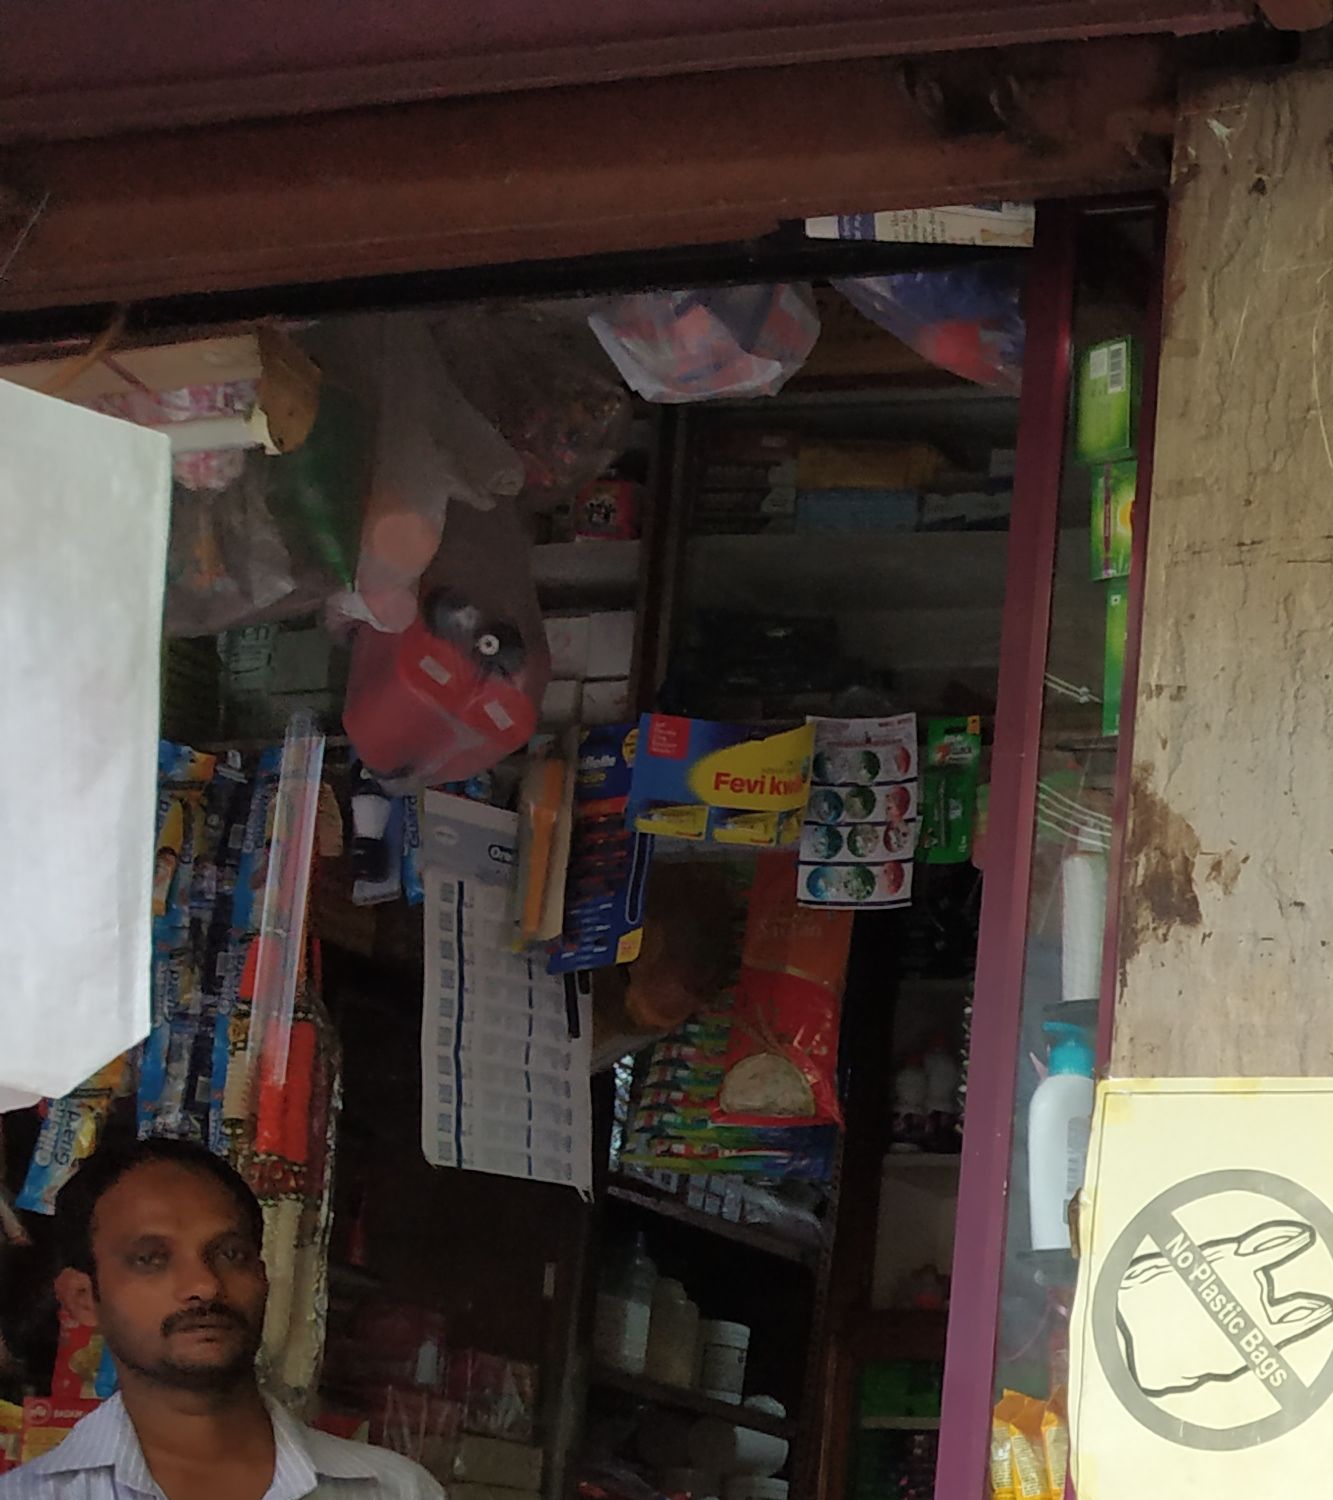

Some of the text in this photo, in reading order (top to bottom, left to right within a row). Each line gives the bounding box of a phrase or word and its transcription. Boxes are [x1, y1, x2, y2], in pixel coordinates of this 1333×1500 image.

[713, 771, 766, 796] Fevi
[1164, 1230, 1289, 1390] No Plastic Bags
